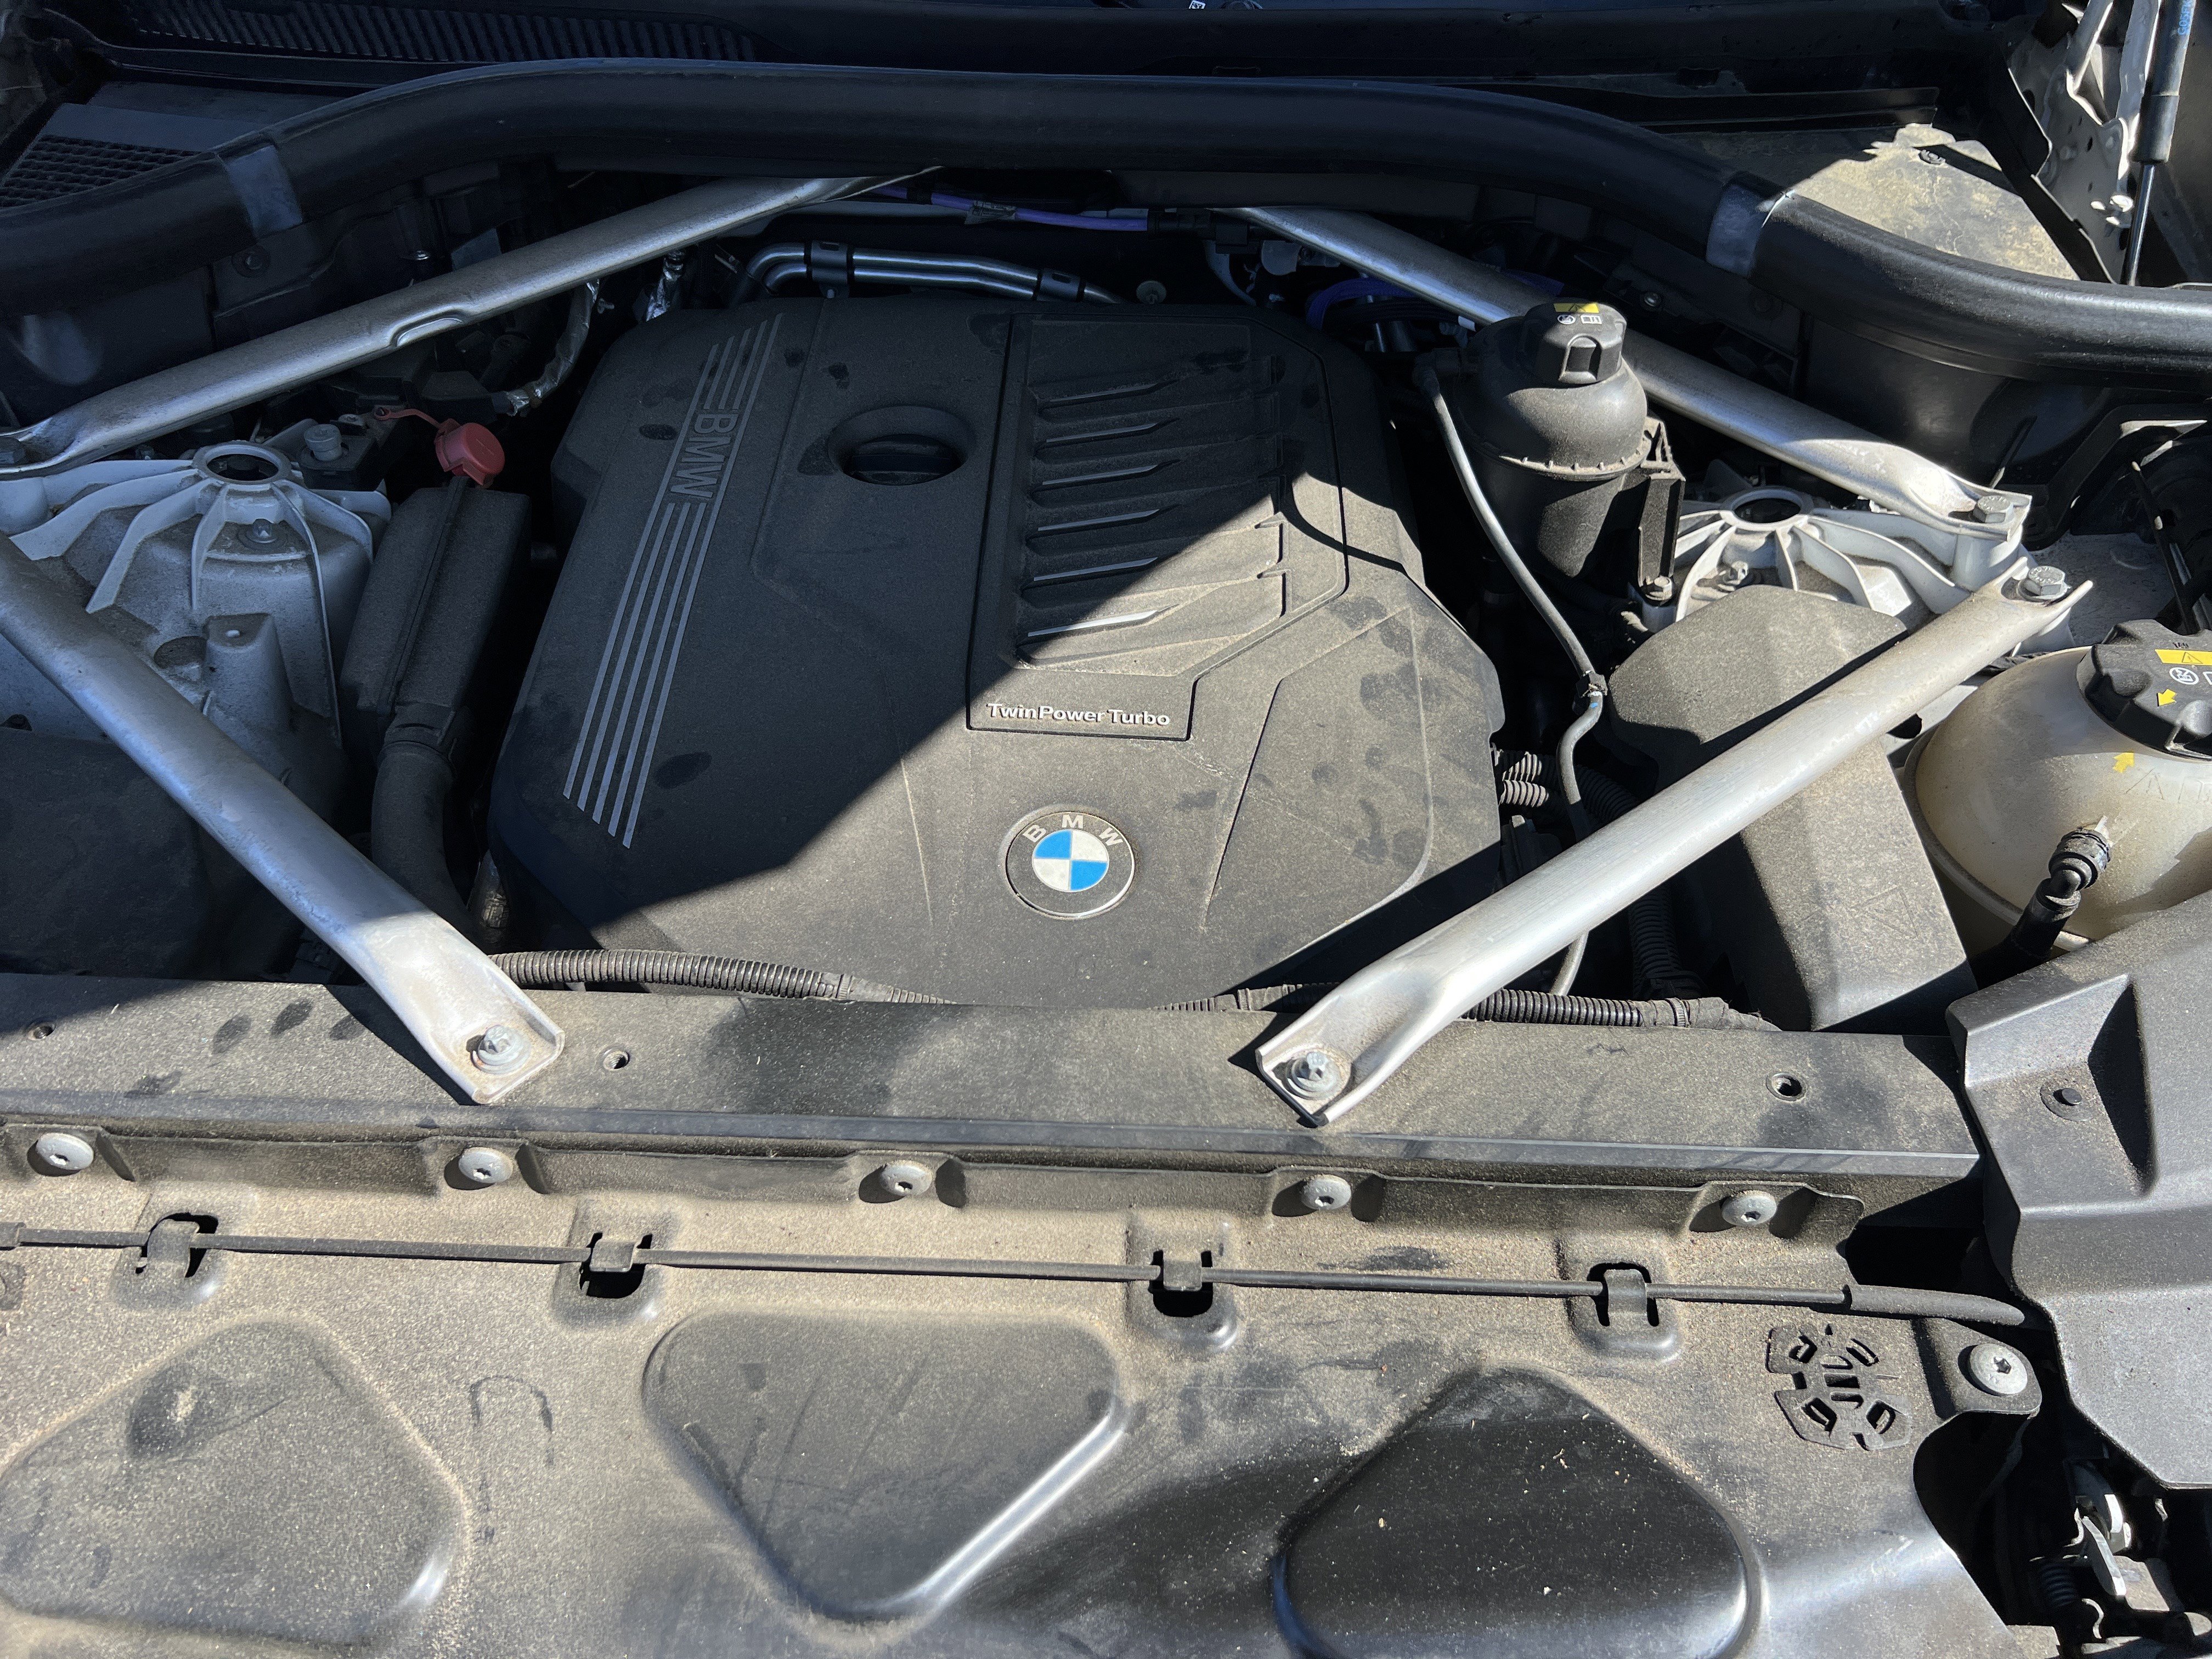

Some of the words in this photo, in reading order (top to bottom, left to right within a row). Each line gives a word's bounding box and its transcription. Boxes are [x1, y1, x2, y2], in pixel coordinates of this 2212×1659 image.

[670, 413, 739, 498] BMW
[987, 703, 1105, 722] TwinPower
[1108, 709, 1171, 726] Turbo
[1023, 814, 1123, 847] BMW
